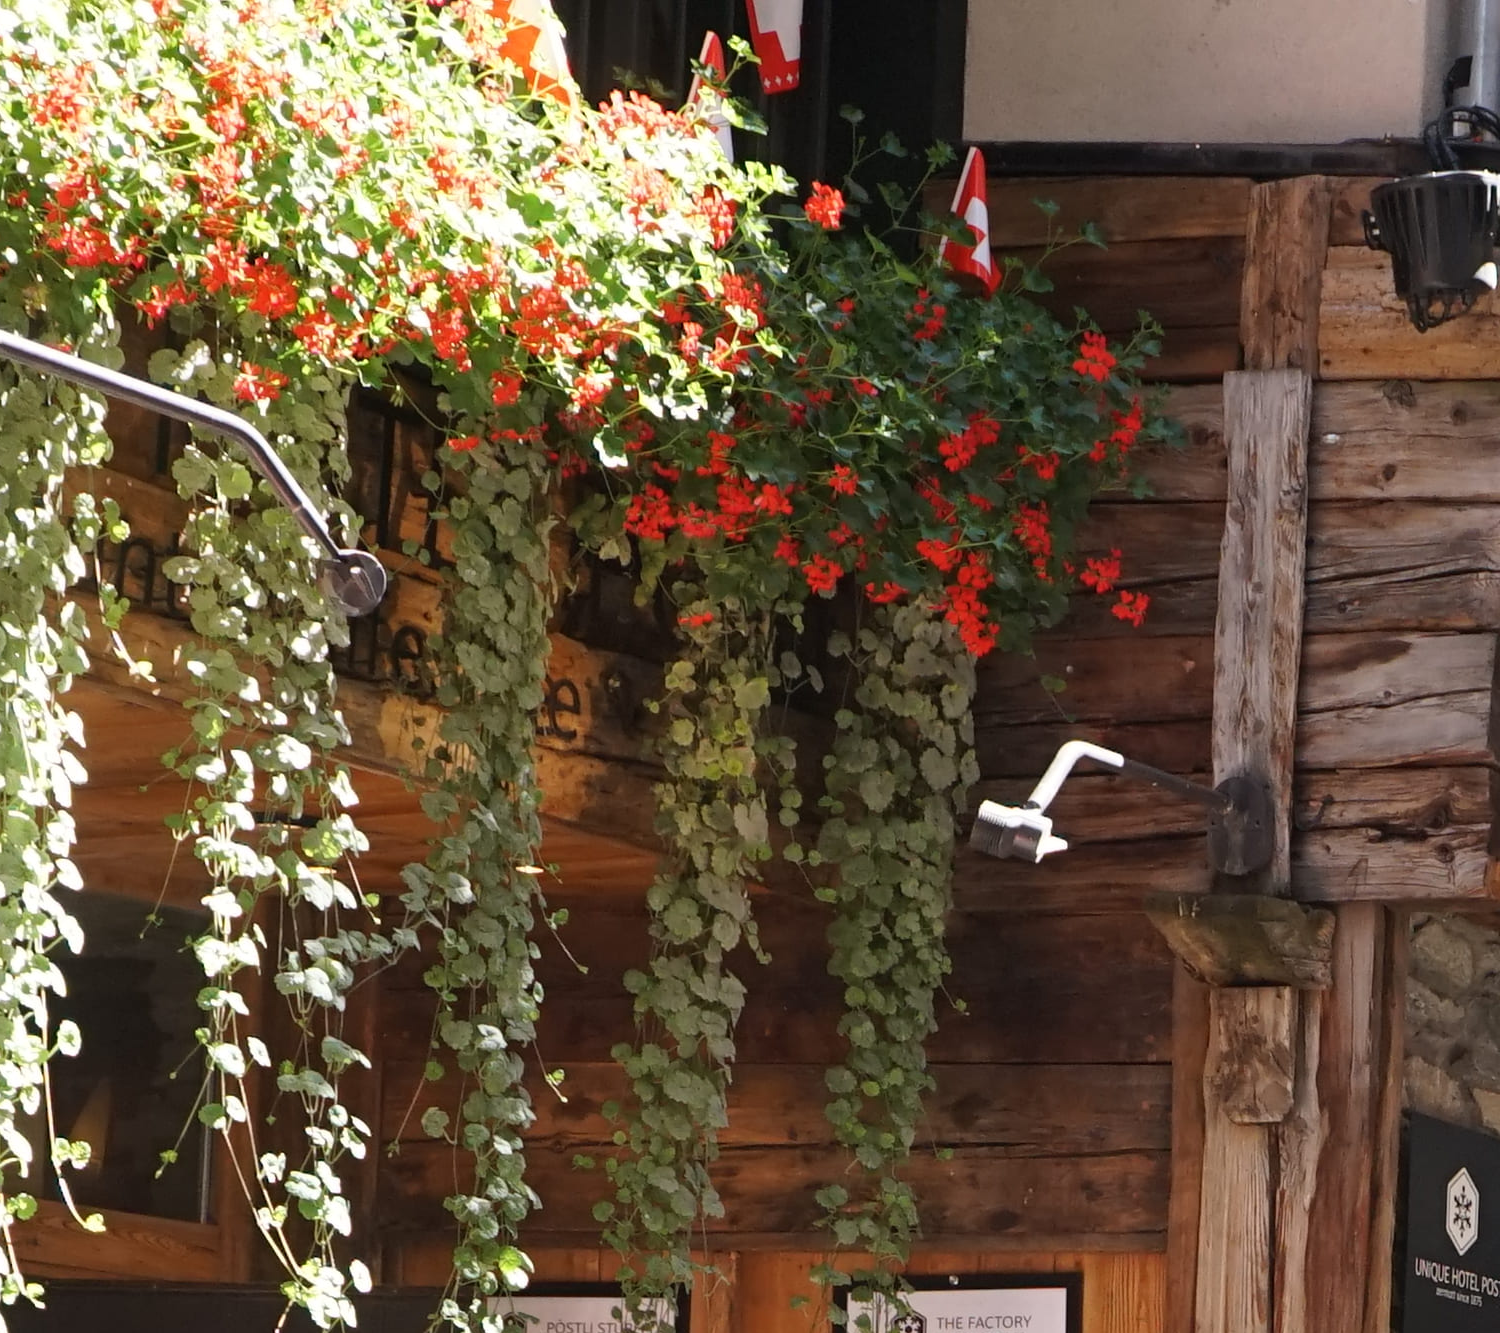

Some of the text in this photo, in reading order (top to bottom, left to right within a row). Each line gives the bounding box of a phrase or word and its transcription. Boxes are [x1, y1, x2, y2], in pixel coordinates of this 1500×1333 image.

[1415, 1257, 1450, 1284] UNIQUE
[1451, 1267, 1480, 1292] HOTEL
[936, 1315, 1032, 1329] THE FACTORY
